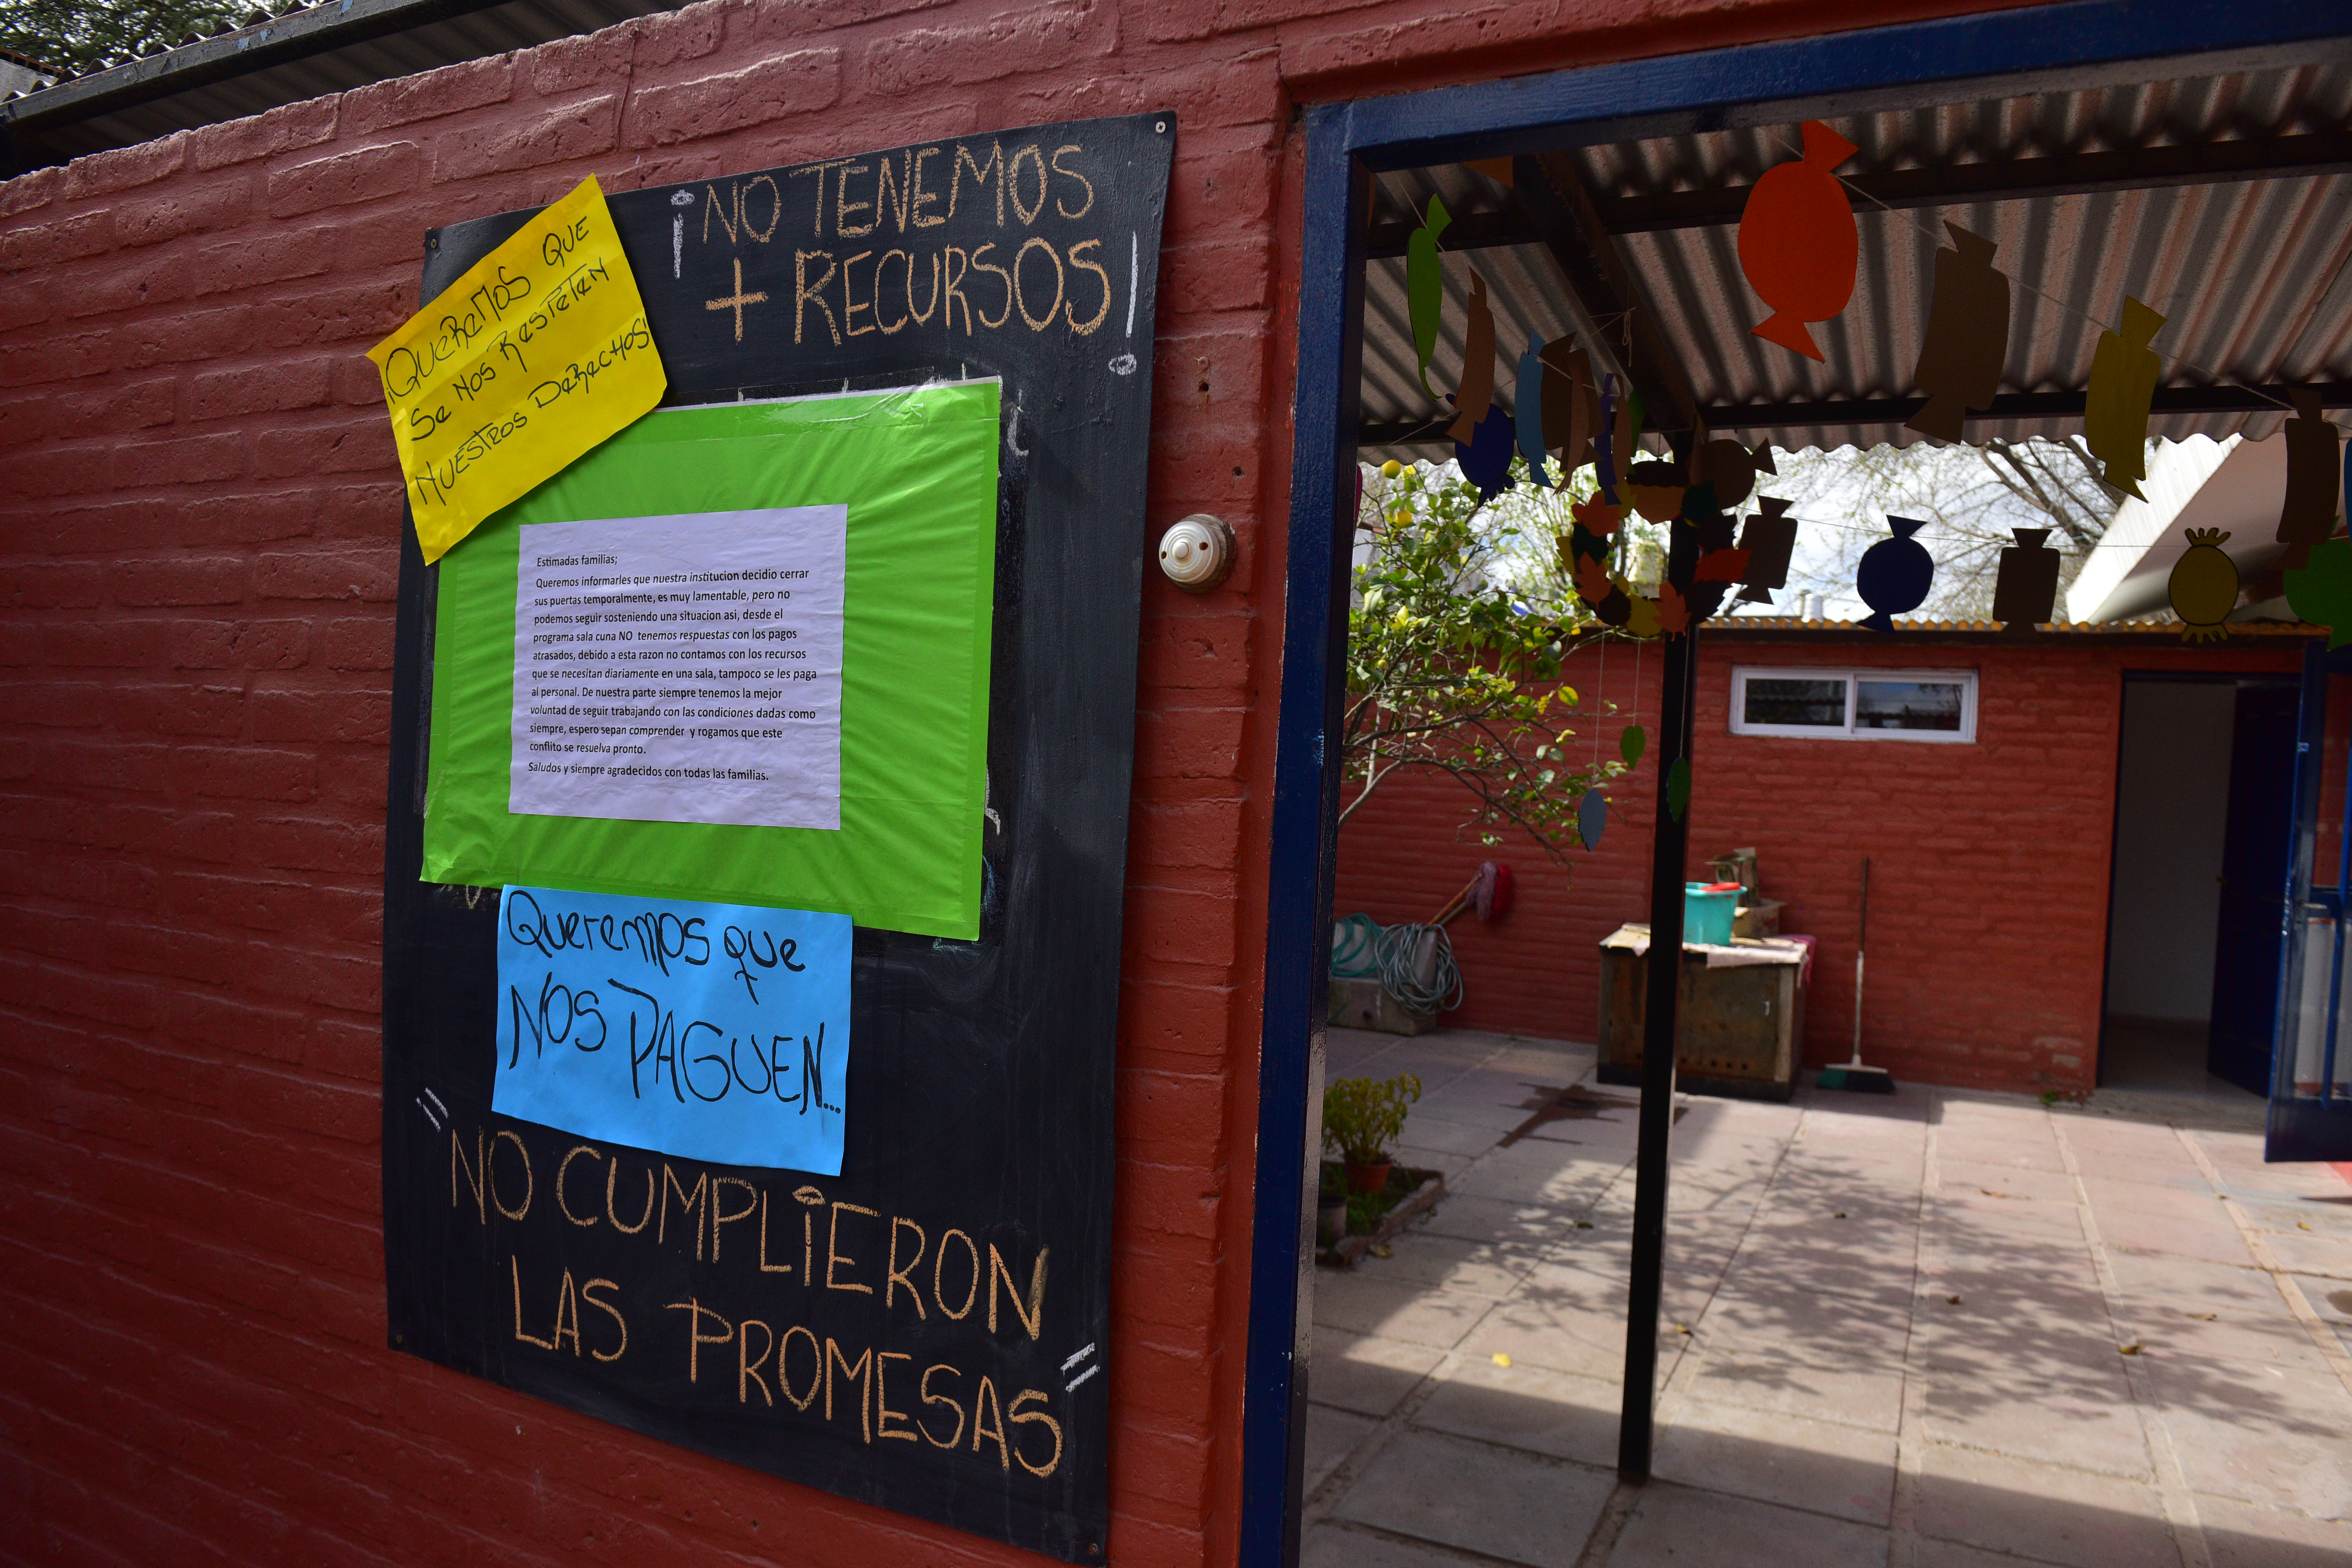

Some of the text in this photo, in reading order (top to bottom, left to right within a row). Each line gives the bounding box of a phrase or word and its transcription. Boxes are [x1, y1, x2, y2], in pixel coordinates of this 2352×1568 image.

[789, 137, 1095, 239] TENEMOS
[542, 216, 589, 268] QUE
[452, 362, 496, 401] NOS
[415, 412, 528, 507] NUESTROS
[537, 553, 618, 567] Estimadas familias;
[536, 568, 810, 589] Queremos informarles que nuestra institucion decidio cerrar
[550, 596, 581, 608] puertas
[583, 593, 656, 606] temporalmente,
[657, 594, 668, 602] es
[670, 594, 691, 604] muy
[693, 589, 749, 602] lamentable,
[752, 591, 775, 602] pero
[777, 591, 790, 599] no
[534, 608, 783, 626] podemos seguir sosteniendo una situacion asi, desde el
[533, 628, 797, 644] programa sala cuna NO tenemos respuestas con los pagos
[533, 649, 576, 662] atrasados,
[578, 649, 608, 660] debido
[618, 650, 636, 660] esta
[639, 651, 663, 660] razon
[680, 649, 726, 659] contamos
[729, 651, 745, 659] con
[748, 648, 762, 659] los
[765, 651, 806, 659] recursos
[532, 671, 548, 680] que
[562, 668, 602, 678] necesitan
[605, 668, 659, 678] diariamente
[695, 667, 716, 680] sala,
[718, 669, 761, 681] tampoco
[764, 671, 774, 679] se
[777, 668, 791, 679] les
[793, 671, 817, 681] paga
[531, 686, 782, 701] al personal. De nuestra parte siempre tenemos la mejor
[530, 704, 816, 719] voluntad de seguir trabajando con las condiciones dadas como
[530, 723, 783, 740] siempre, espero sepan comprender y rogamos que este
[530, 741, 562, 752] conflito
[576, 742, 611, 753] resuelva
[613, 744, 646, 756] pronto.
[528, 762, 769, 781] Saludos y siempre agradecidos con todas las familias.
[508, 971, 607, 1070] NOS
[510, 1254, 628, 1362] LAS
